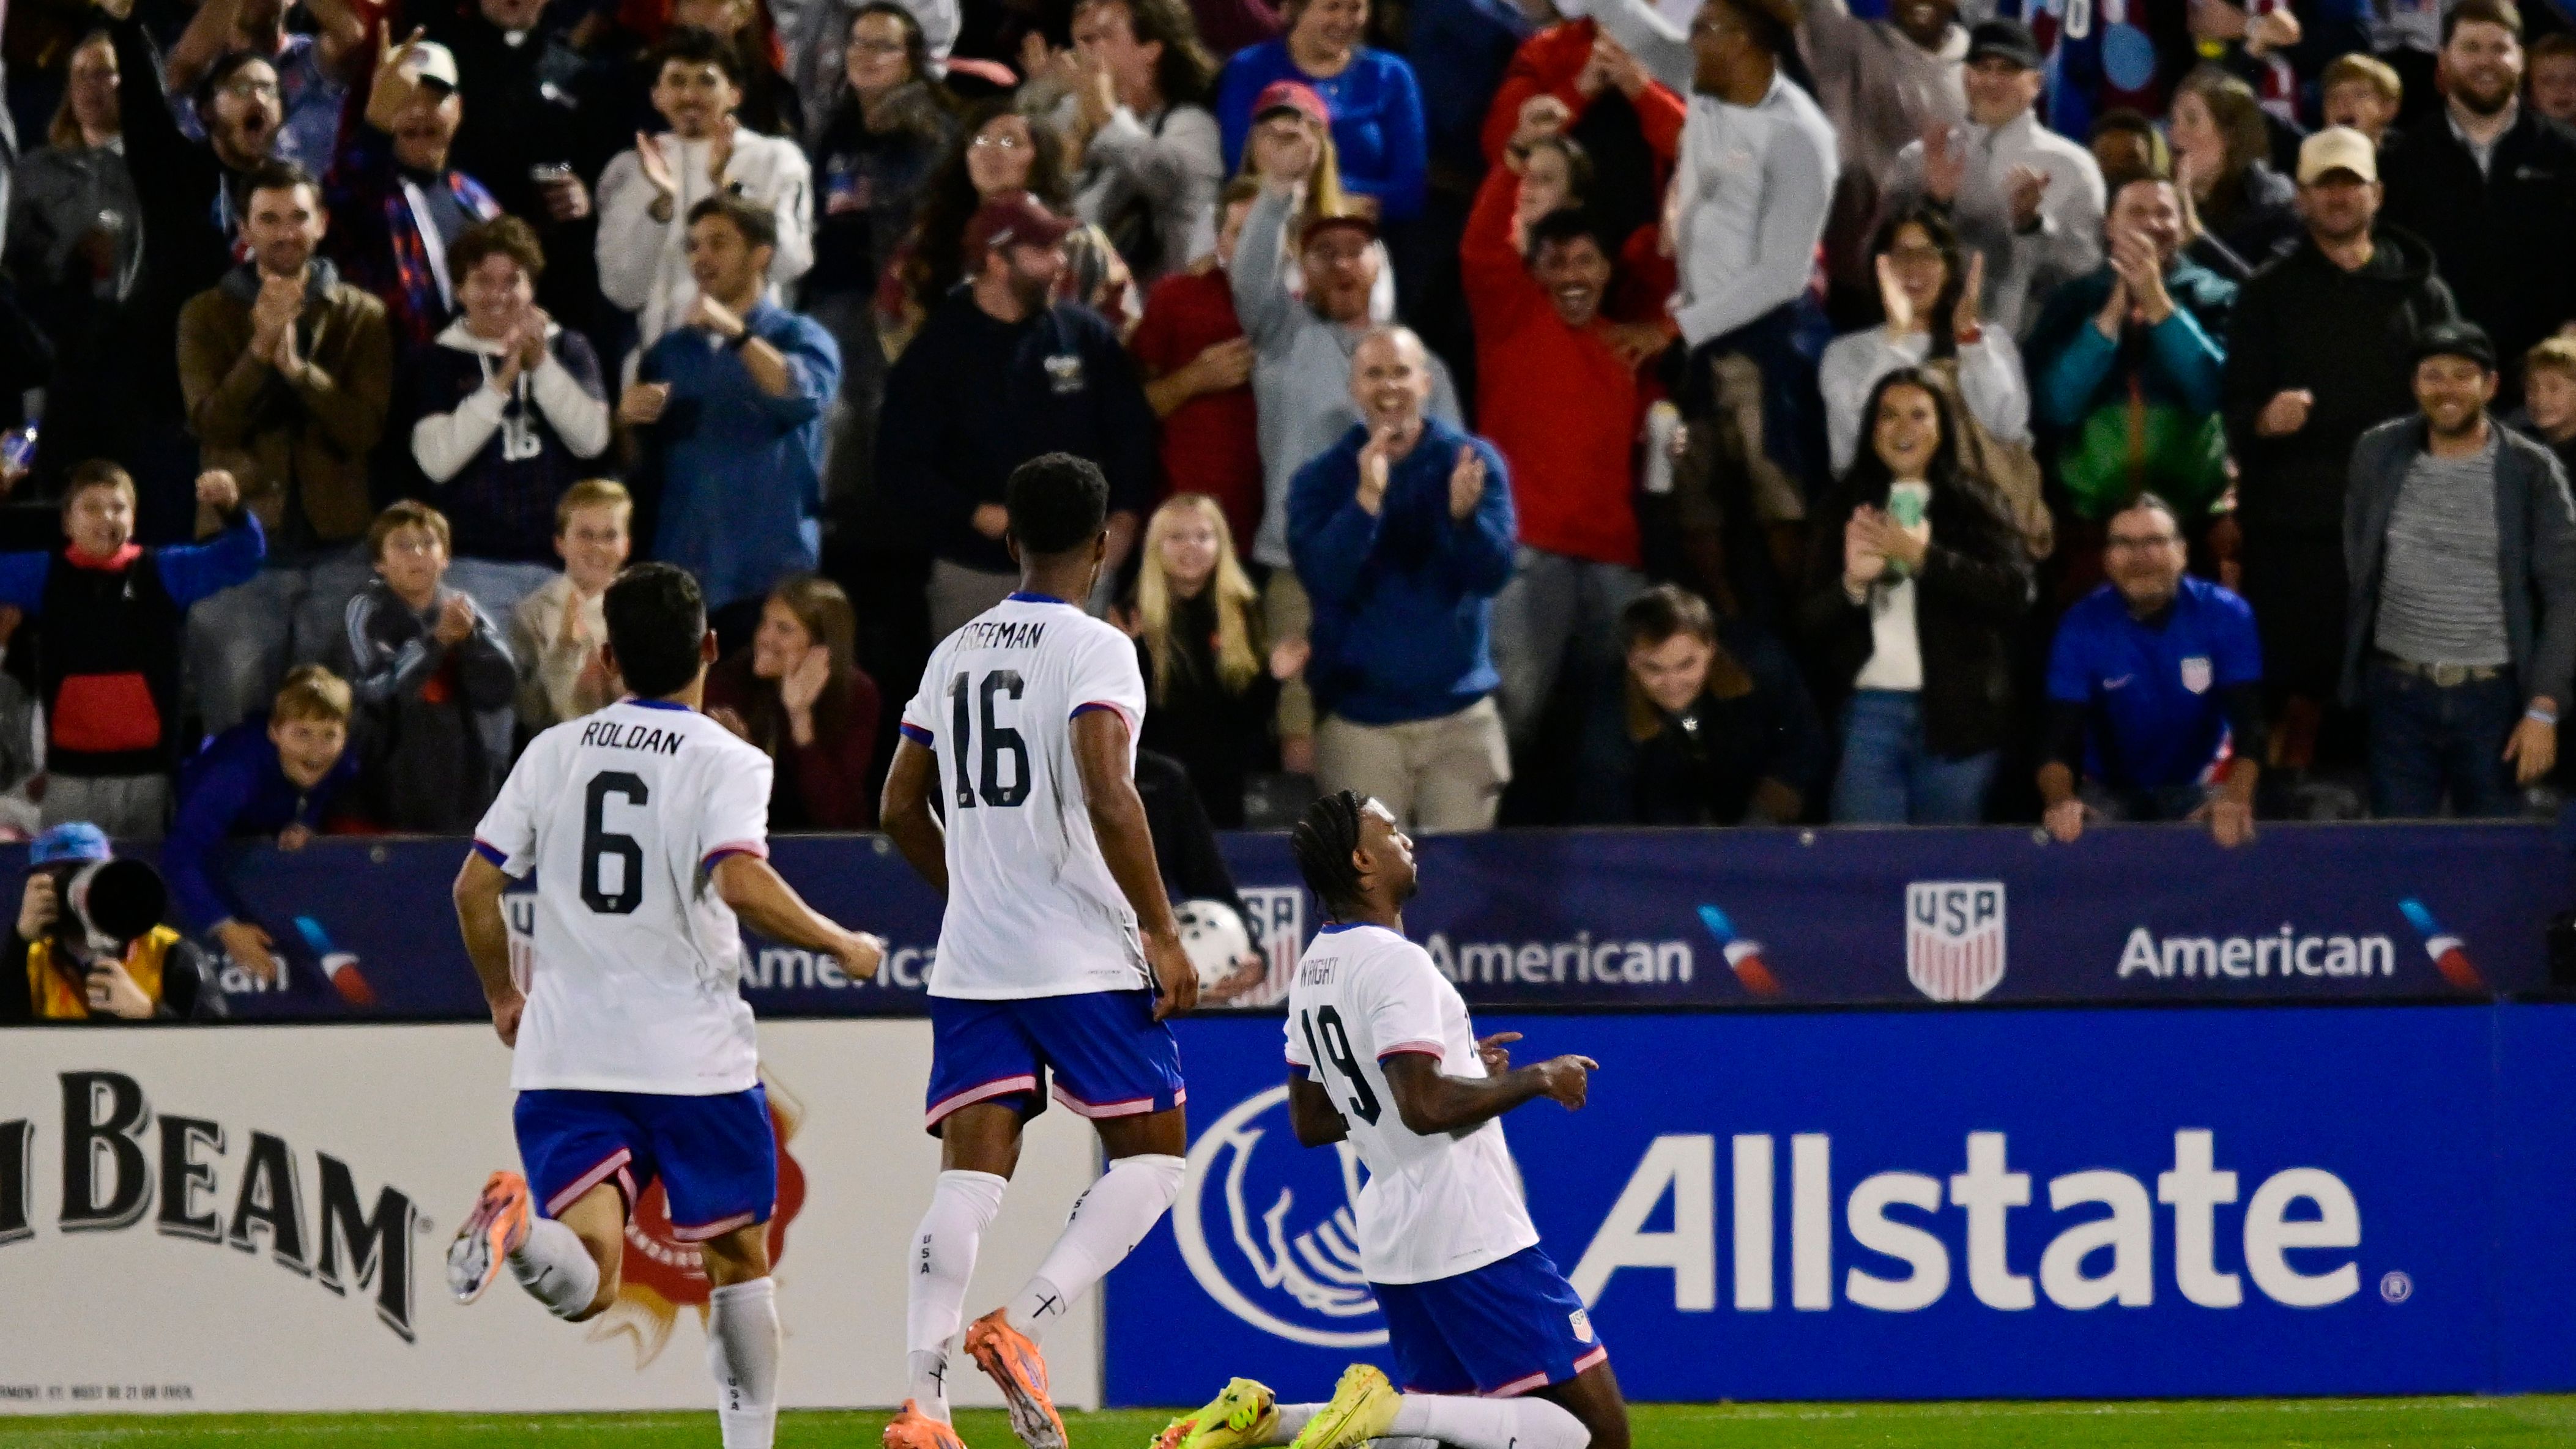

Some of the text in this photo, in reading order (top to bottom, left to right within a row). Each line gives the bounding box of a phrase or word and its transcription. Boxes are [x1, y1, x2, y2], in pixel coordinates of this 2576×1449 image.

[580, 722, 685, 757] ROLDAN
[947, 670, 1031, 809] 16
[580, 771, 648, 914] 6
[1913, 889, 1997, 938] USA
[1300, 957, 1339, 989] WRIGHT
[1424, 930, 1693, 984] American
[2116, 921, 2395, 979] American
[1301, 1004, 1381, 1132] 19
[58, 1069, 417, 1345] BEAM
[1568, 1128, 2362, 1313] Allstate
[920, 1234, 932, 1275] USA
